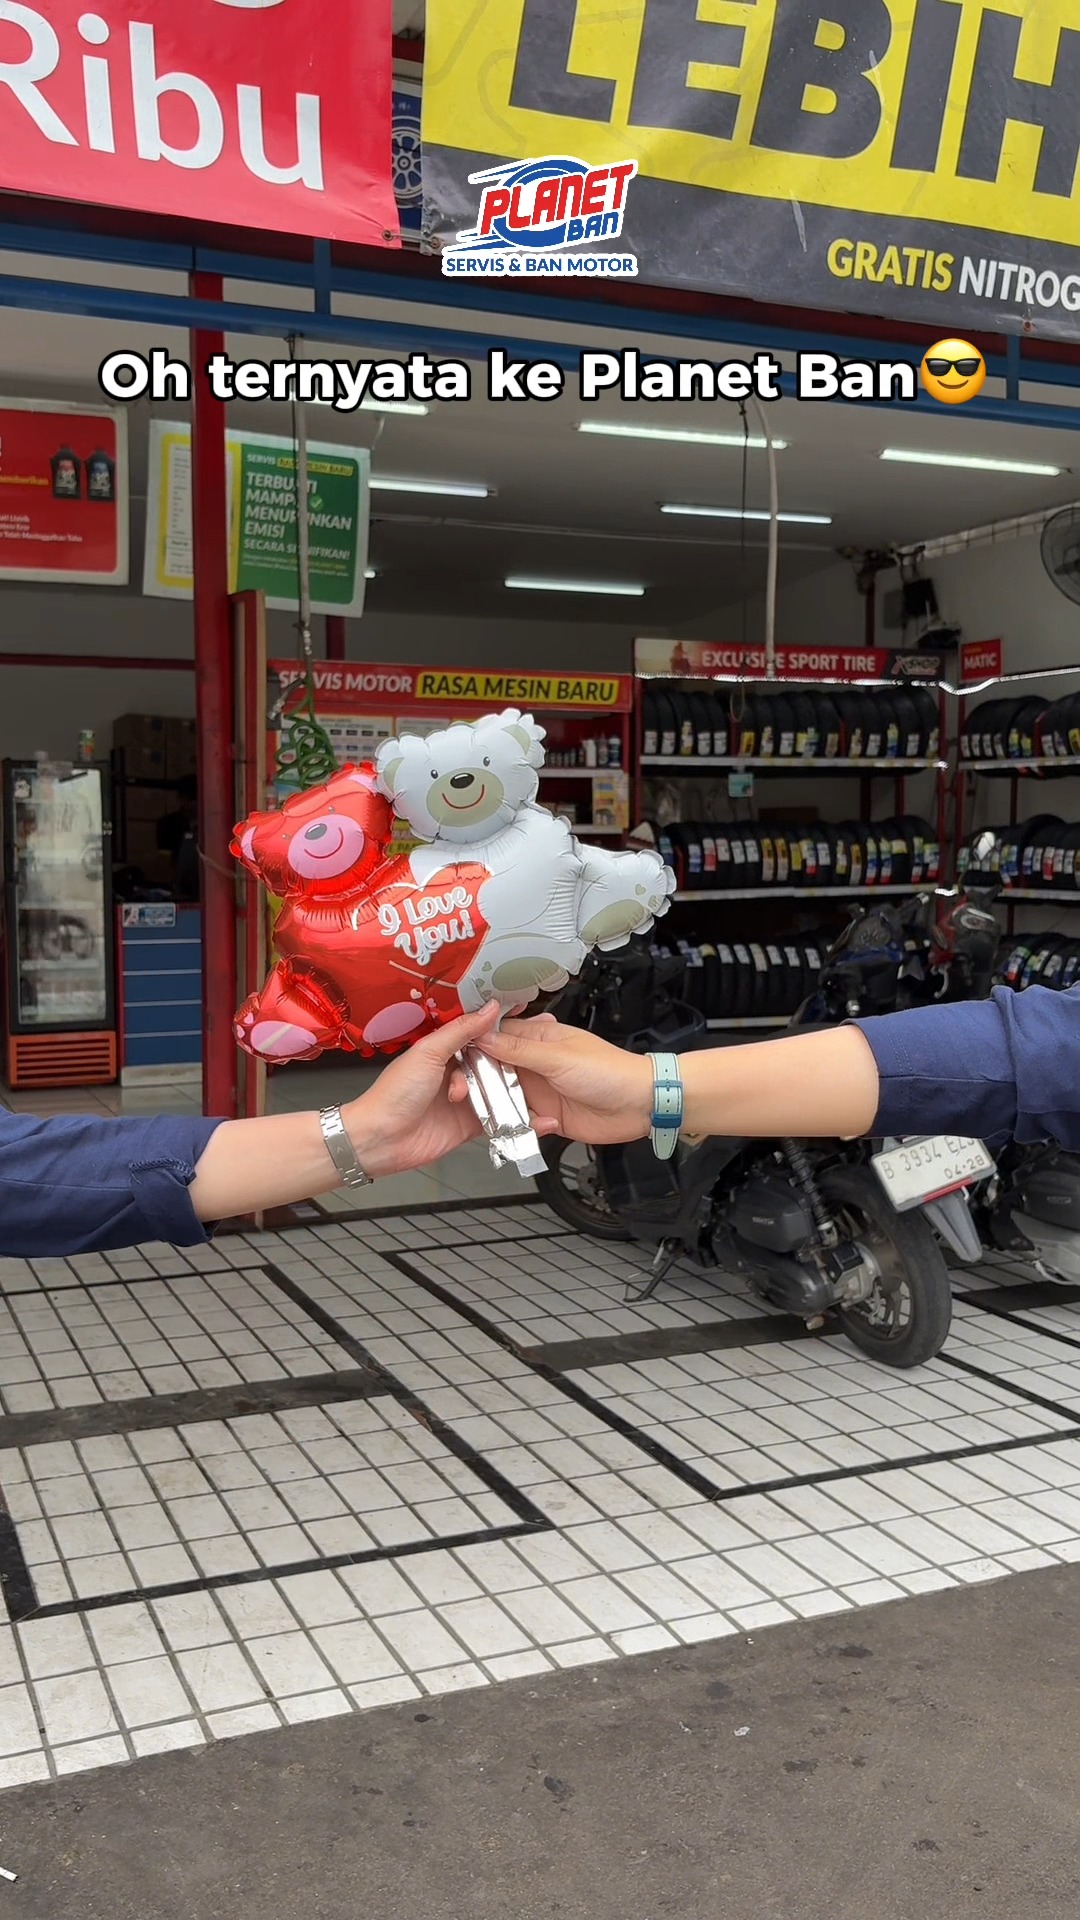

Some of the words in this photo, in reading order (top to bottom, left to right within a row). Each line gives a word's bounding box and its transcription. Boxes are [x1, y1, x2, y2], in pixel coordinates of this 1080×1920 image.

[0, 6, 326, 191] Ribu
[508, 0, 1080, 199] LEBIH
[826, 238, 956, 292] GRATIS
[246, 472, 317, 494] TERBUTI
[243, 521, 285, 539] EMISI
[243, 538, 284, 553] SECARA
[788, 653, 838, 671] SPORT
[841, 655, 876, 673] TIRE
[963, 653, 998, 670] MATIC
[345, 673, 413, 693] MOTOR
[421, 675, 479, 696] RASA
[483, 677, 551, 699] MESIN
[556, 680, 614, 701] BARU
[378, 903, 402, 936] I
[403, 886, 473, 925] Love
[394, 909, 476, 966] You!
[880, 1159, 896, 1180] B
[898, 1141, 943, 1172] 3934
